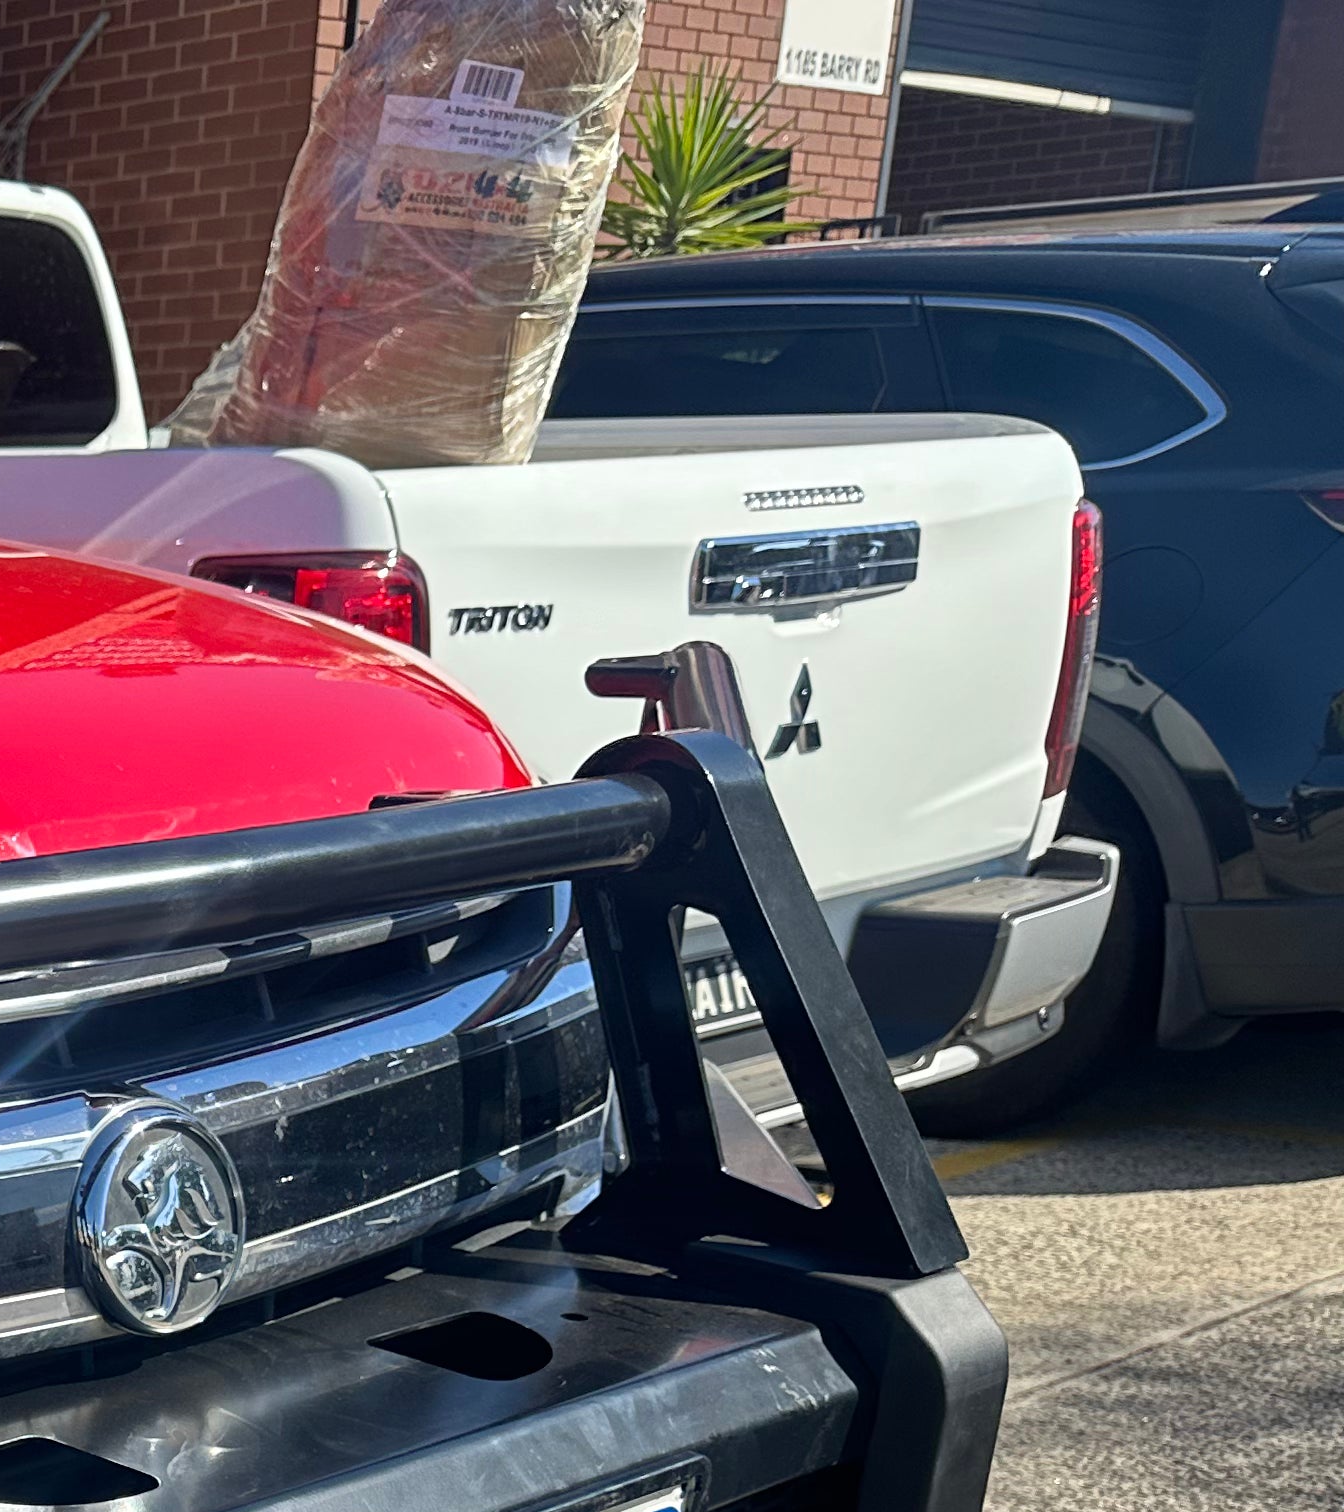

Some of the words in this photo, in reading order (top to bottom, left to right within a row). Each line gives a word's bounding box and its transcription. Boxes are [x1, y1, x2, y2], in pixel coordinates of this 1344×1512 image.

[819, 52, 862, 81] BARRY
[862, 57, 881, 84] RD
[447, 603, 554, 636] TRITON
